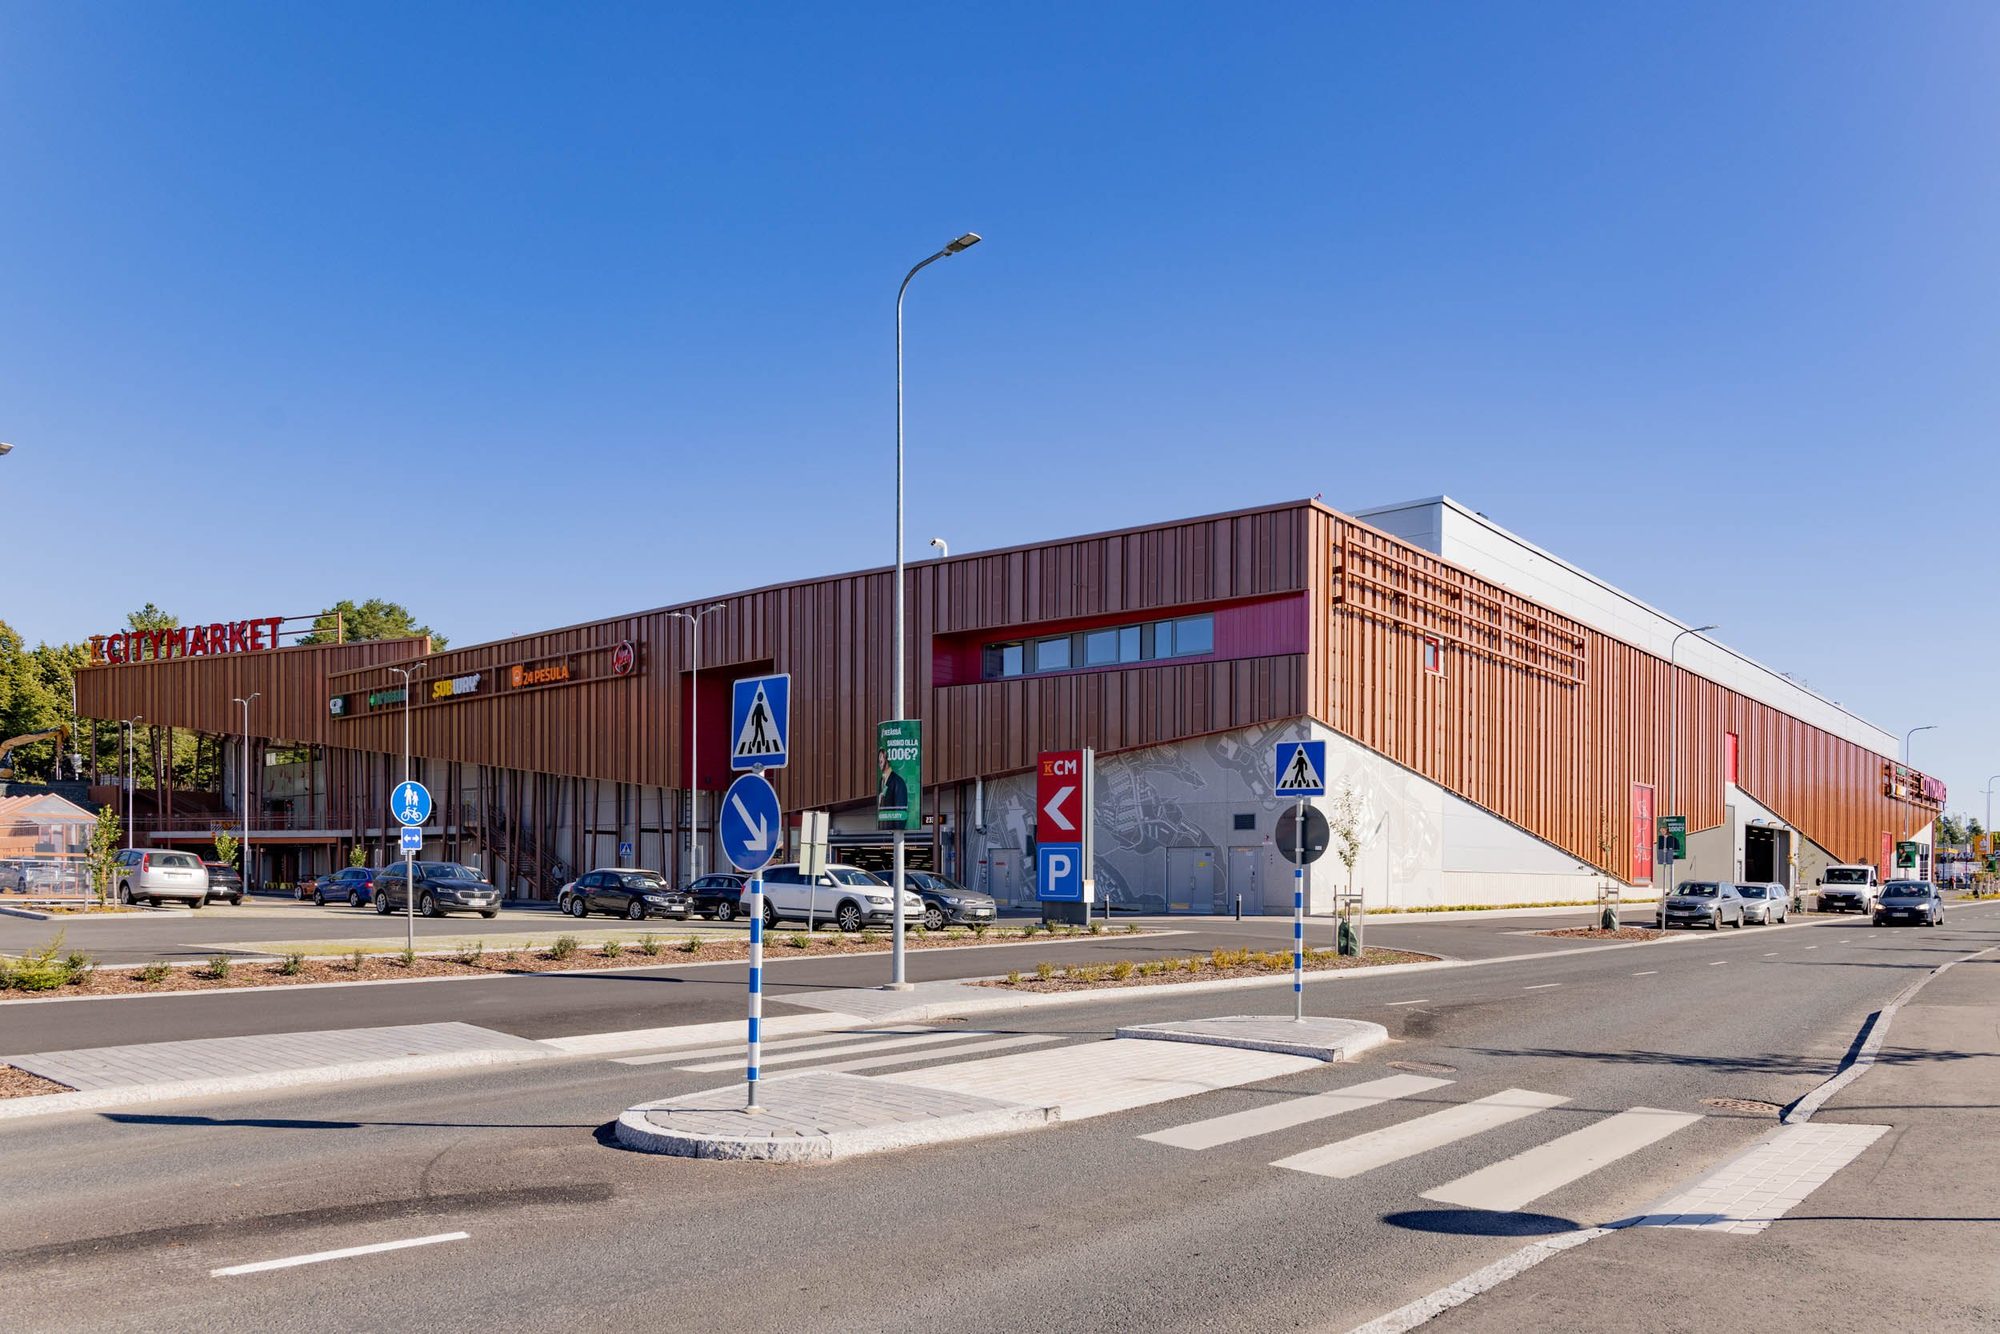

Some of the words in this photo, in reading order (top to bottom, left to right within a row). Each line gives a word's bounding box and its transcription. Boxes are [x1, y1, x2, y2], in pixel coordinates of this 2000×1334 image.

[107, 616, 284, 664] CITYMARKET
[432, 672, 481, 699] SUBWAY
[887, 747, 918, 761] 100€?
[1048, 854, 1072, 891] P
